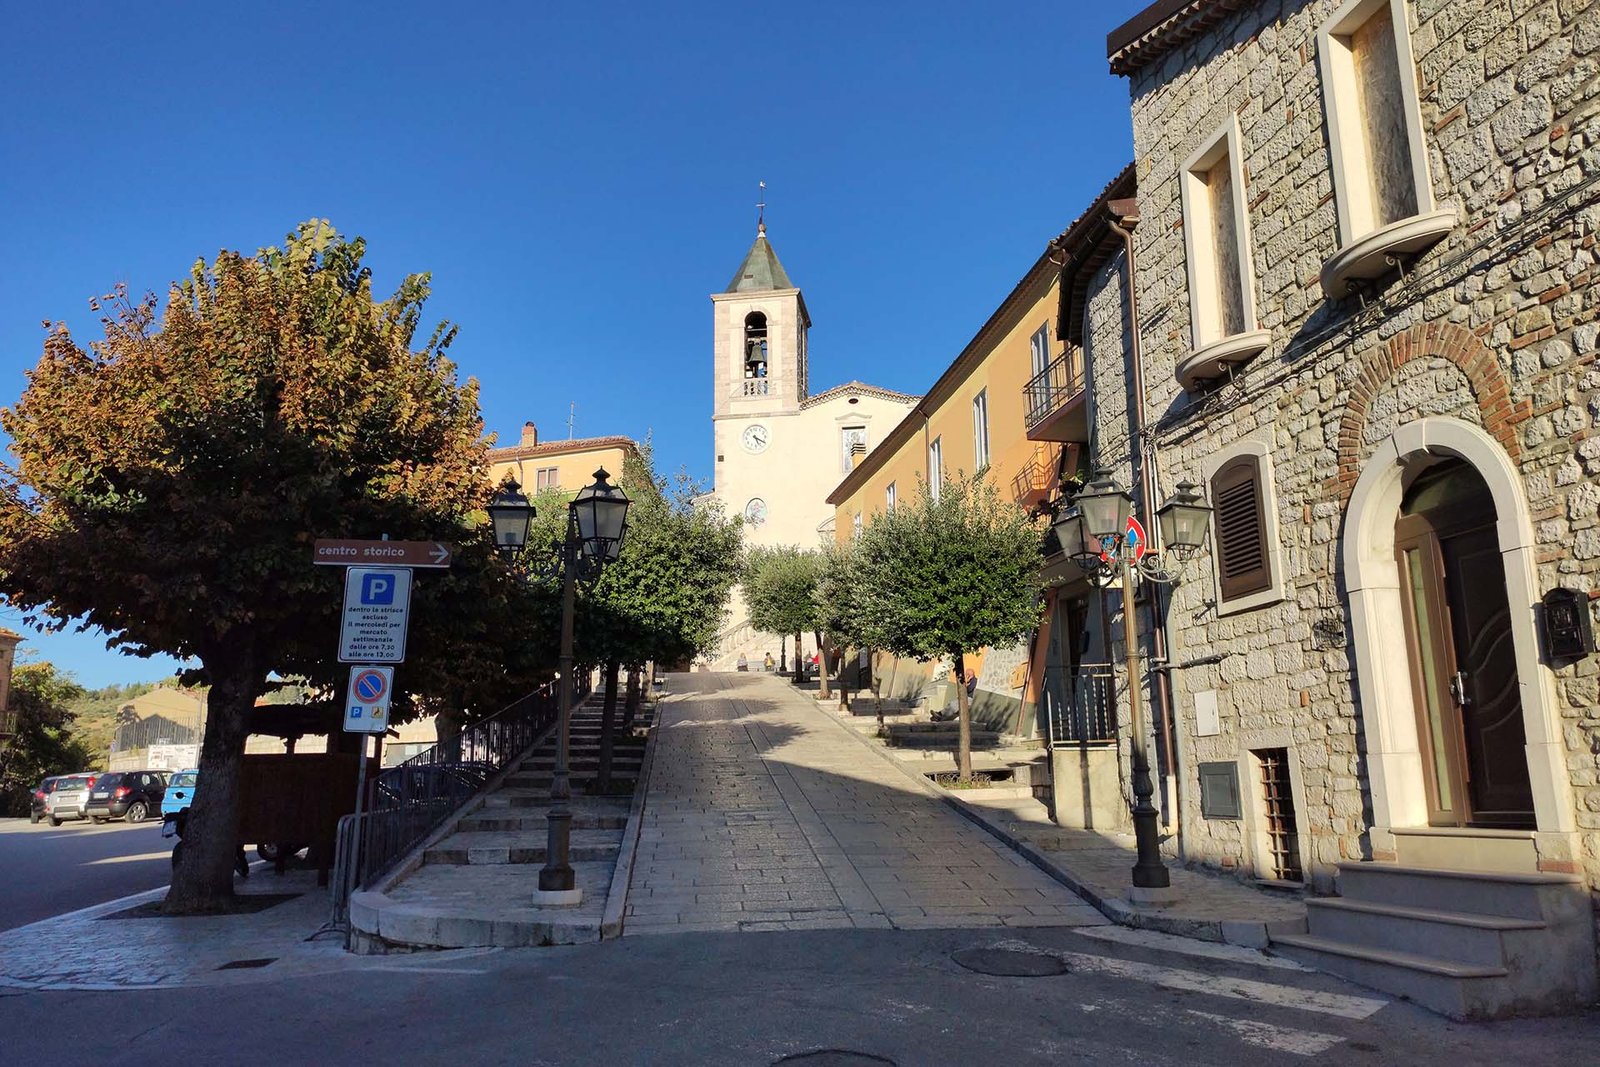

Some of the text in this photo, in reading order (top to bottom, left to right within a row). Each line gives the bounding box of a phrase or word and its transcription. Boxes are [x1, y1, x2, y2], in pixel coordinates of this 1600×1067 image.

[318, 546, 405, 556] centro storico
[369, 579, 388, 600] P
[353, 708, 360, 716] P
